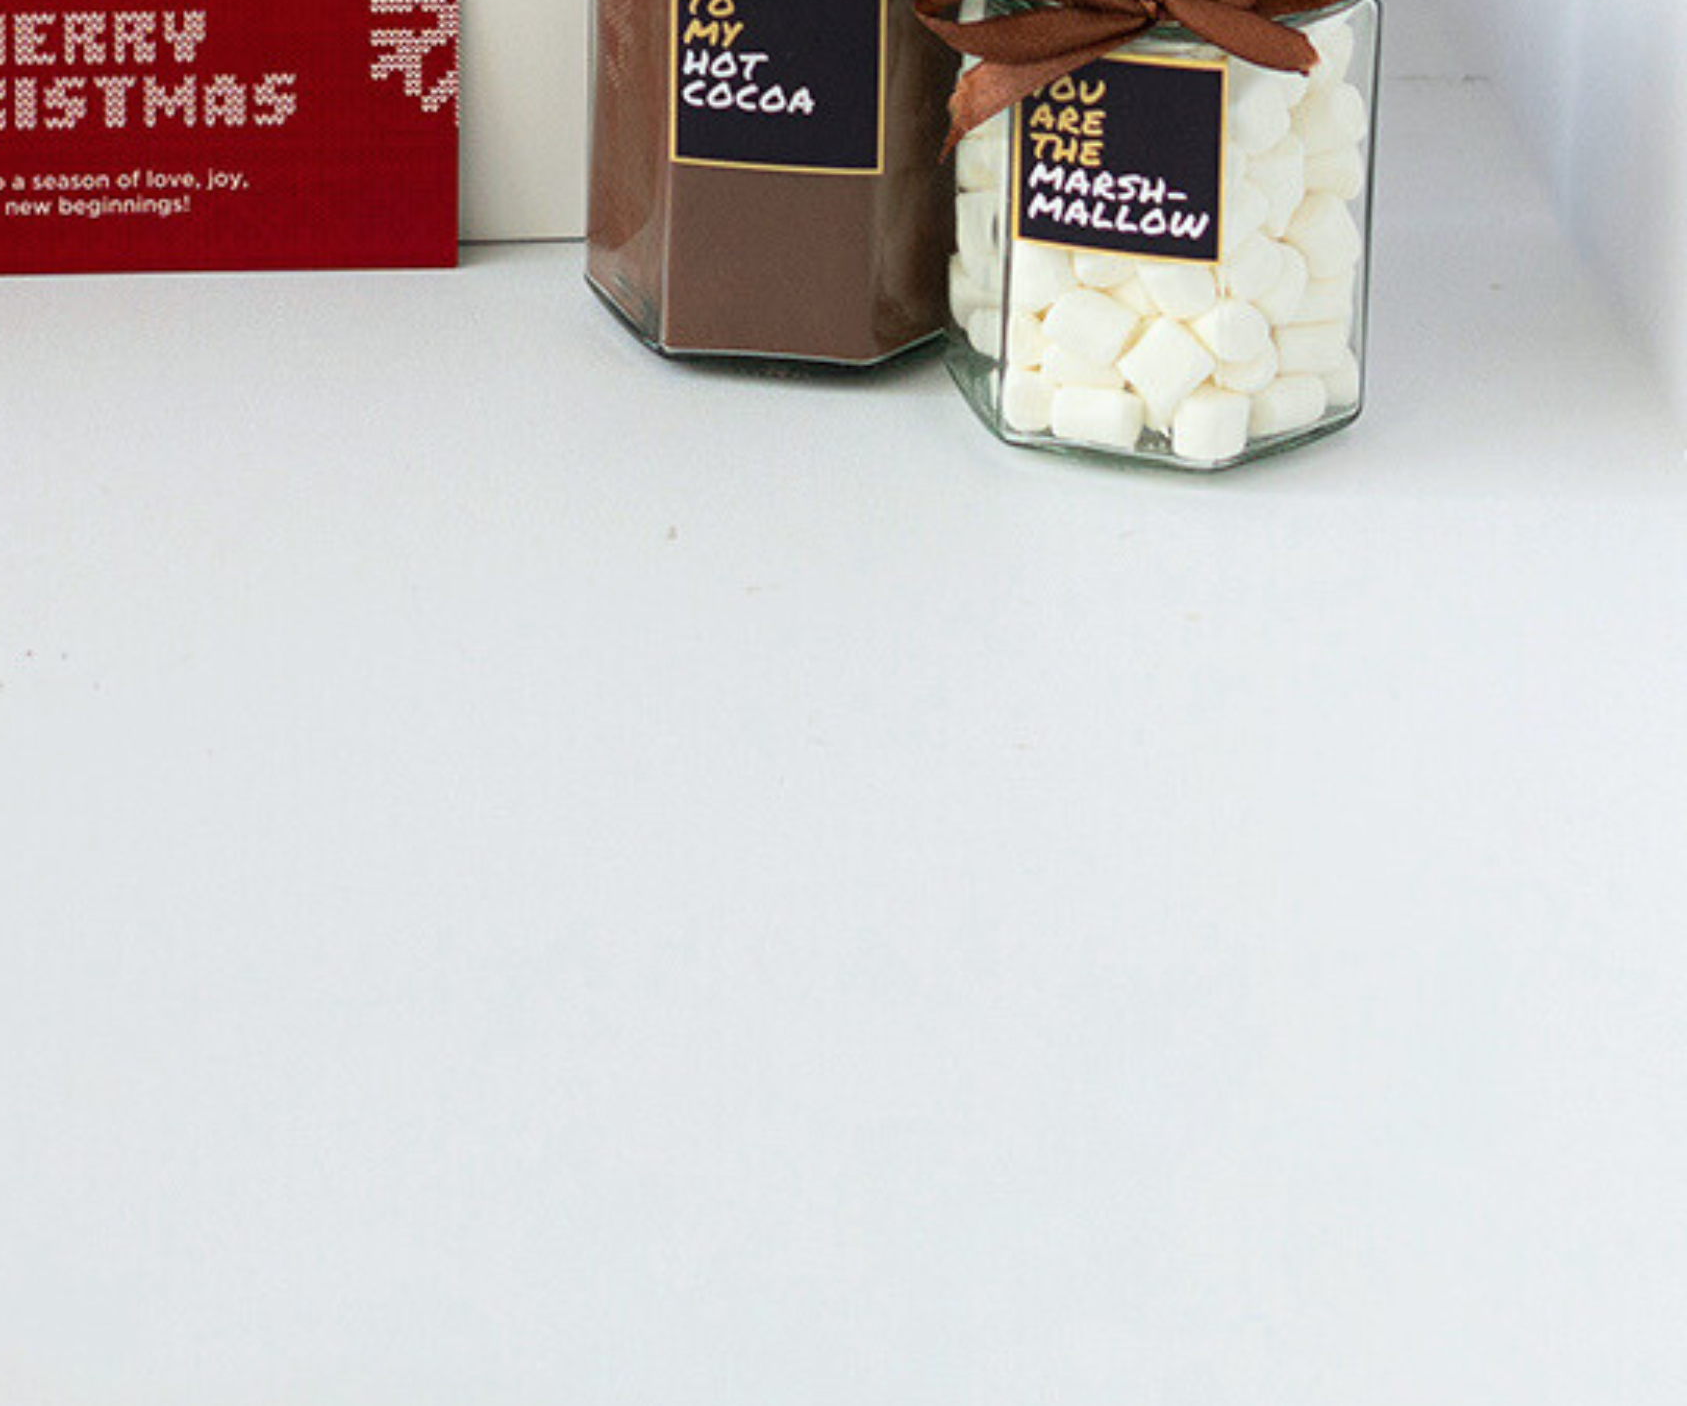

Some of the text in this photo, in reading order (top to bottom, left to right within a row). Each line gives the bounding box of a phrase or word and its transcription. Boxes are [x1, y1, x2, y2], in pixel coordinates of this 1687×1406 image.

[683, 19, 744, 47] MY
[682, 48, 769, 80] HOT
[682, 81, 816, 115] COCOA
[1033, 75, 1106, 103] OU
[1029, 103, 1106, 137] ARE
[1029, 131, 1104, 166] THE
[11, 176, 26, 190] a
[32, 173, 110, 190] season
[116, 169, 141, 188] of
[145, 169, 201, 190] love,
[205, 167, 250, 190] joy,
[1028, 161, 1189, 202] MARSH-
[4, 198, 52, 215] new
[57, 193, 192, 218] beginnings!
[1027, 192, 1210, 240] MALLOW
